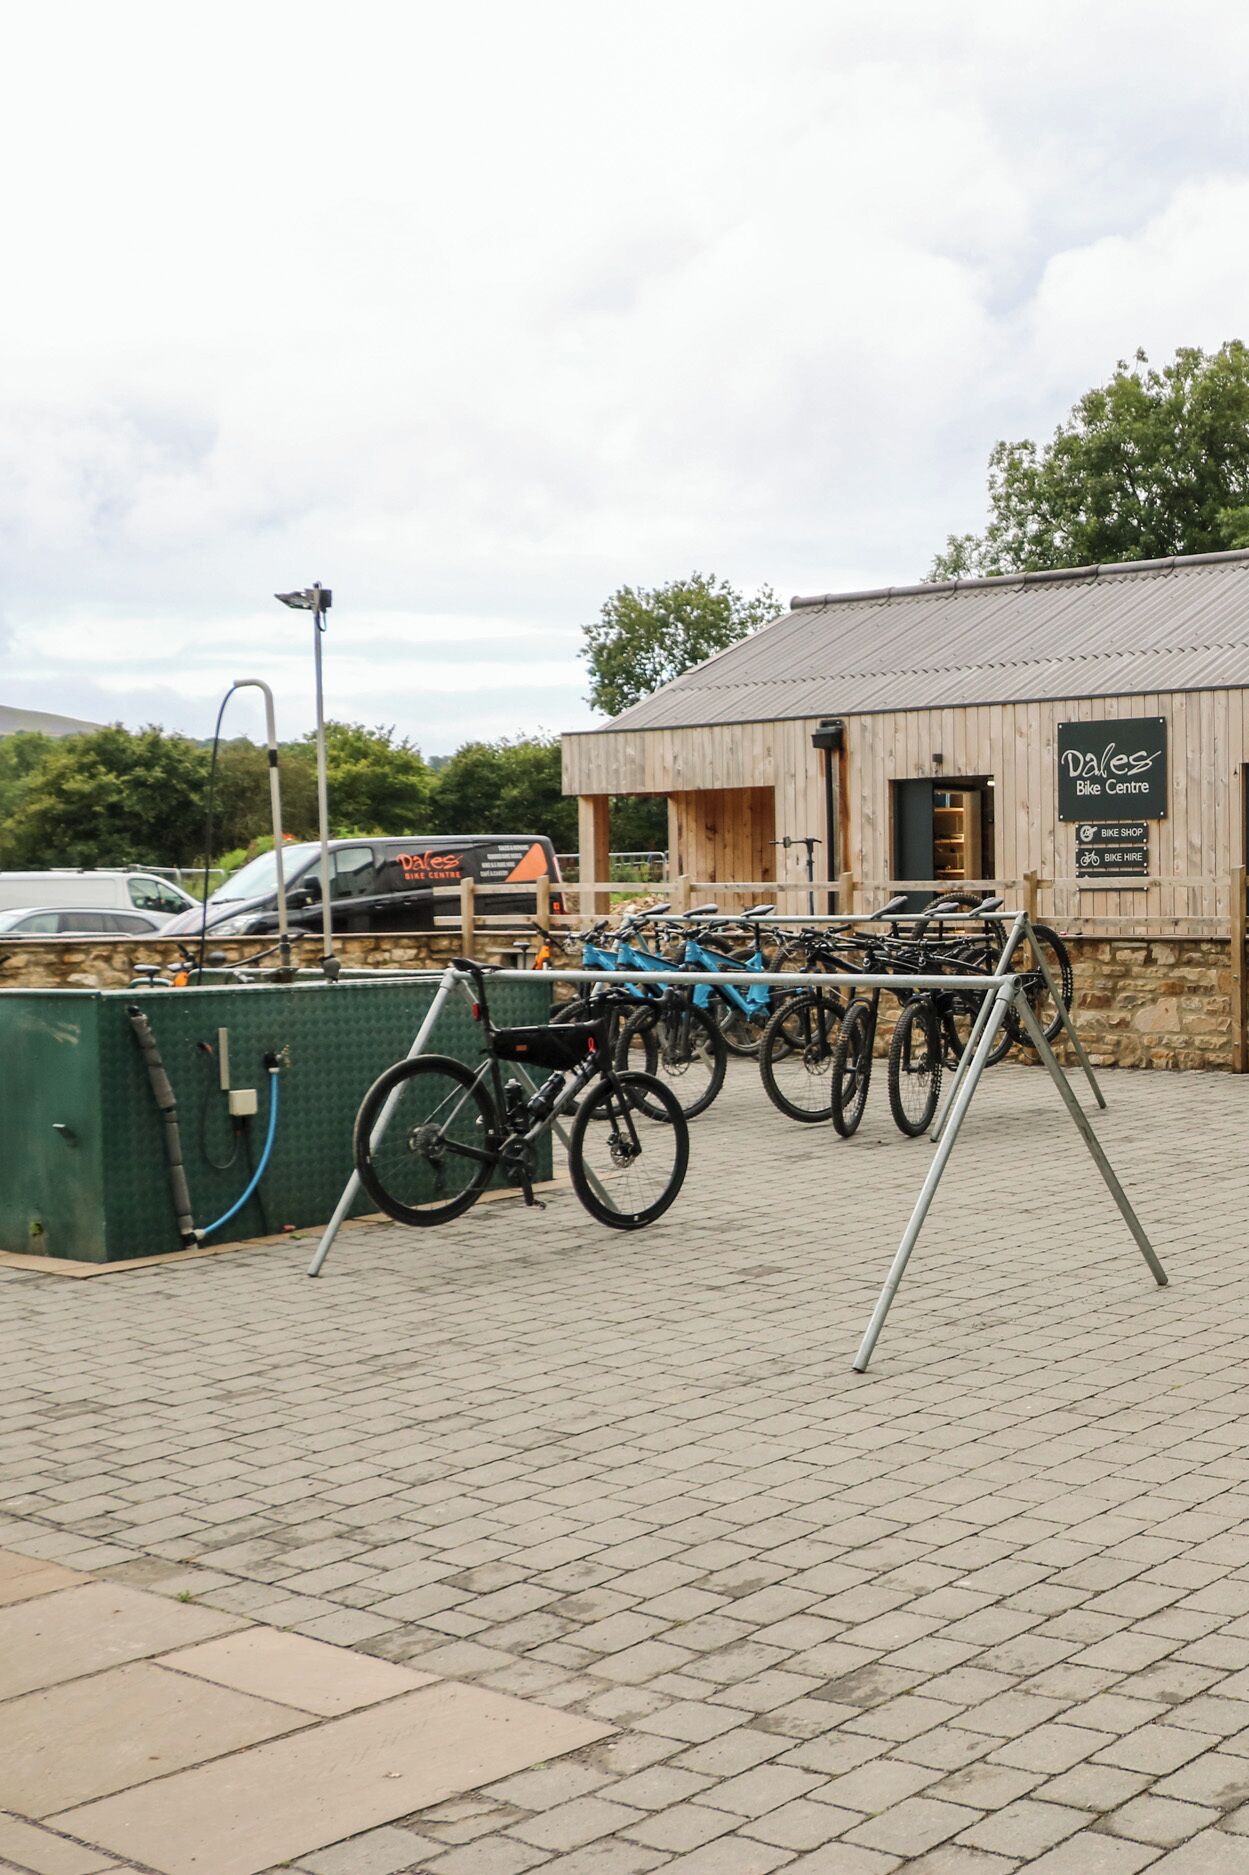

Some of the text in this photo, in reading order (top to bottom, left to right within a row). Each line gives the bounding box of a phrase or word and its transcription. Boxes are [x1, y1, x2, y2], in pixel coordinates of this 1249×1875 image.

[1062, 743, 1161, 777] Dales
[1077, 779, 1149, 795] Bike Centre
[1101, 828, 1143, 837] BIKE SHOP
[397, 850, 463, 870] Dales
[1105, 852, 1142, 862] BIKE HIRE
[405, 871, 461, 880] BIKE CENTRE
